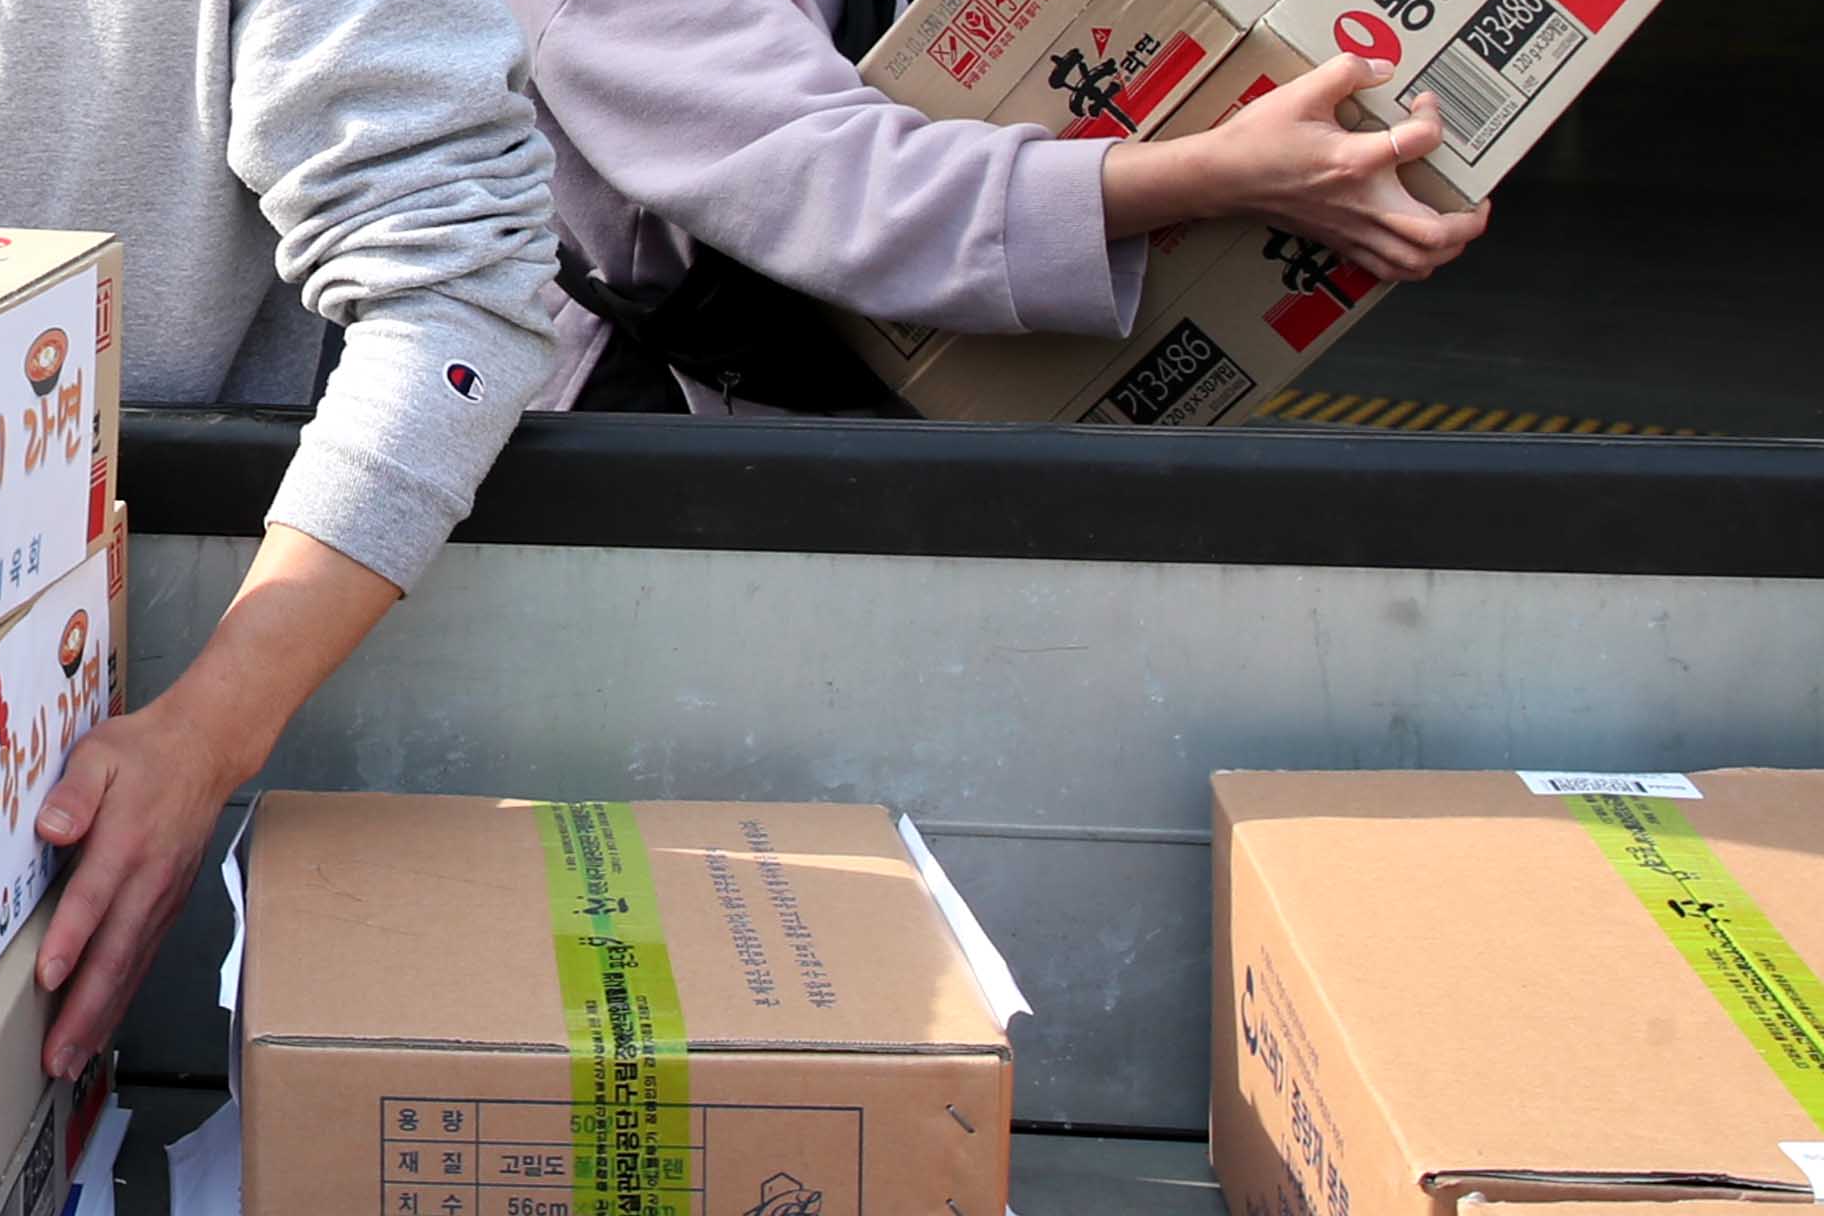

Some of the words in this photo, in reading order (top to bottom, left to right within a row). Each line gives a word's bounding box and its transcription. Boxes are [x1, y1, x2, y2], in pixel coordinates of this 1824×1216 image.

[1049, 48, 1137, 133] 辛
[1122, 32, 1161, 75] 라면
[1118, 329, 1211, 413] 가3486
[23, 367, 83, 475] 라면
[58, 639, 100, 754] 라면
